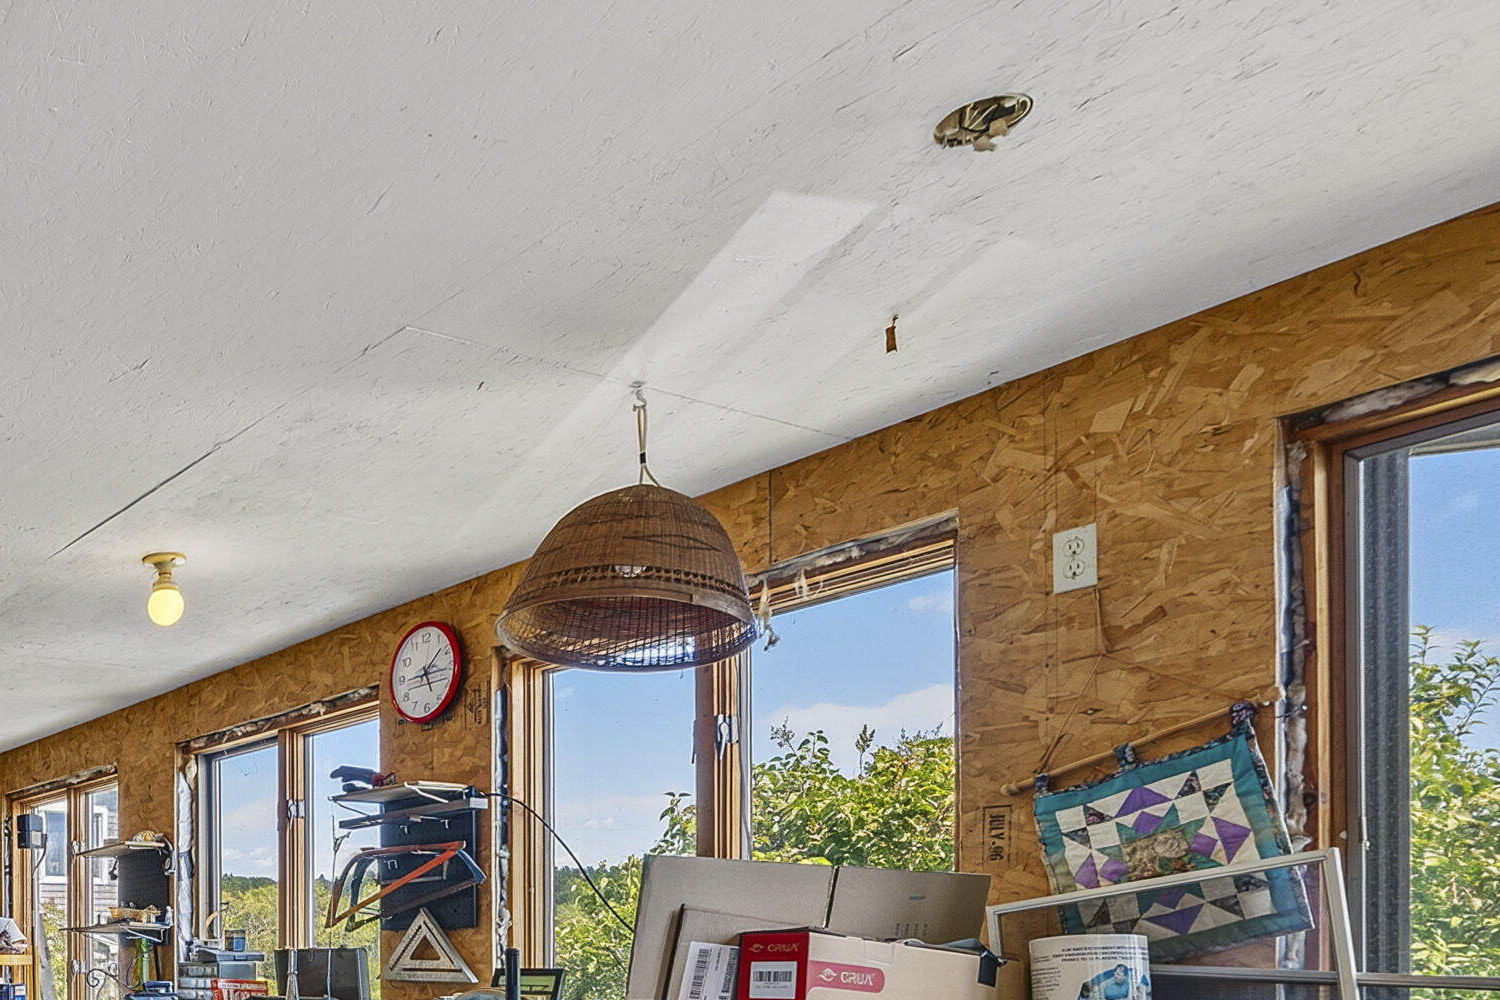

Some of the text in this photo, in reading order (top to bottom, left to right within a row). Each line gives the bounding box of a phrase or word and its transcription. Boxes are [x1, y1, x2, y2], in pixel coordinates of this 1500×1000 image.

[422, 632, 431, 643] 12
[410, 640, 418, 651] 11
[402, 657, 412, 668] 10
[398, 675, 406, 686] 9
[403, 692, 410, 702] 8
[412, 701, 418, 711] 7
[423, 702, 431, 713] 6
[840, 970, 874, 986] CRUA
